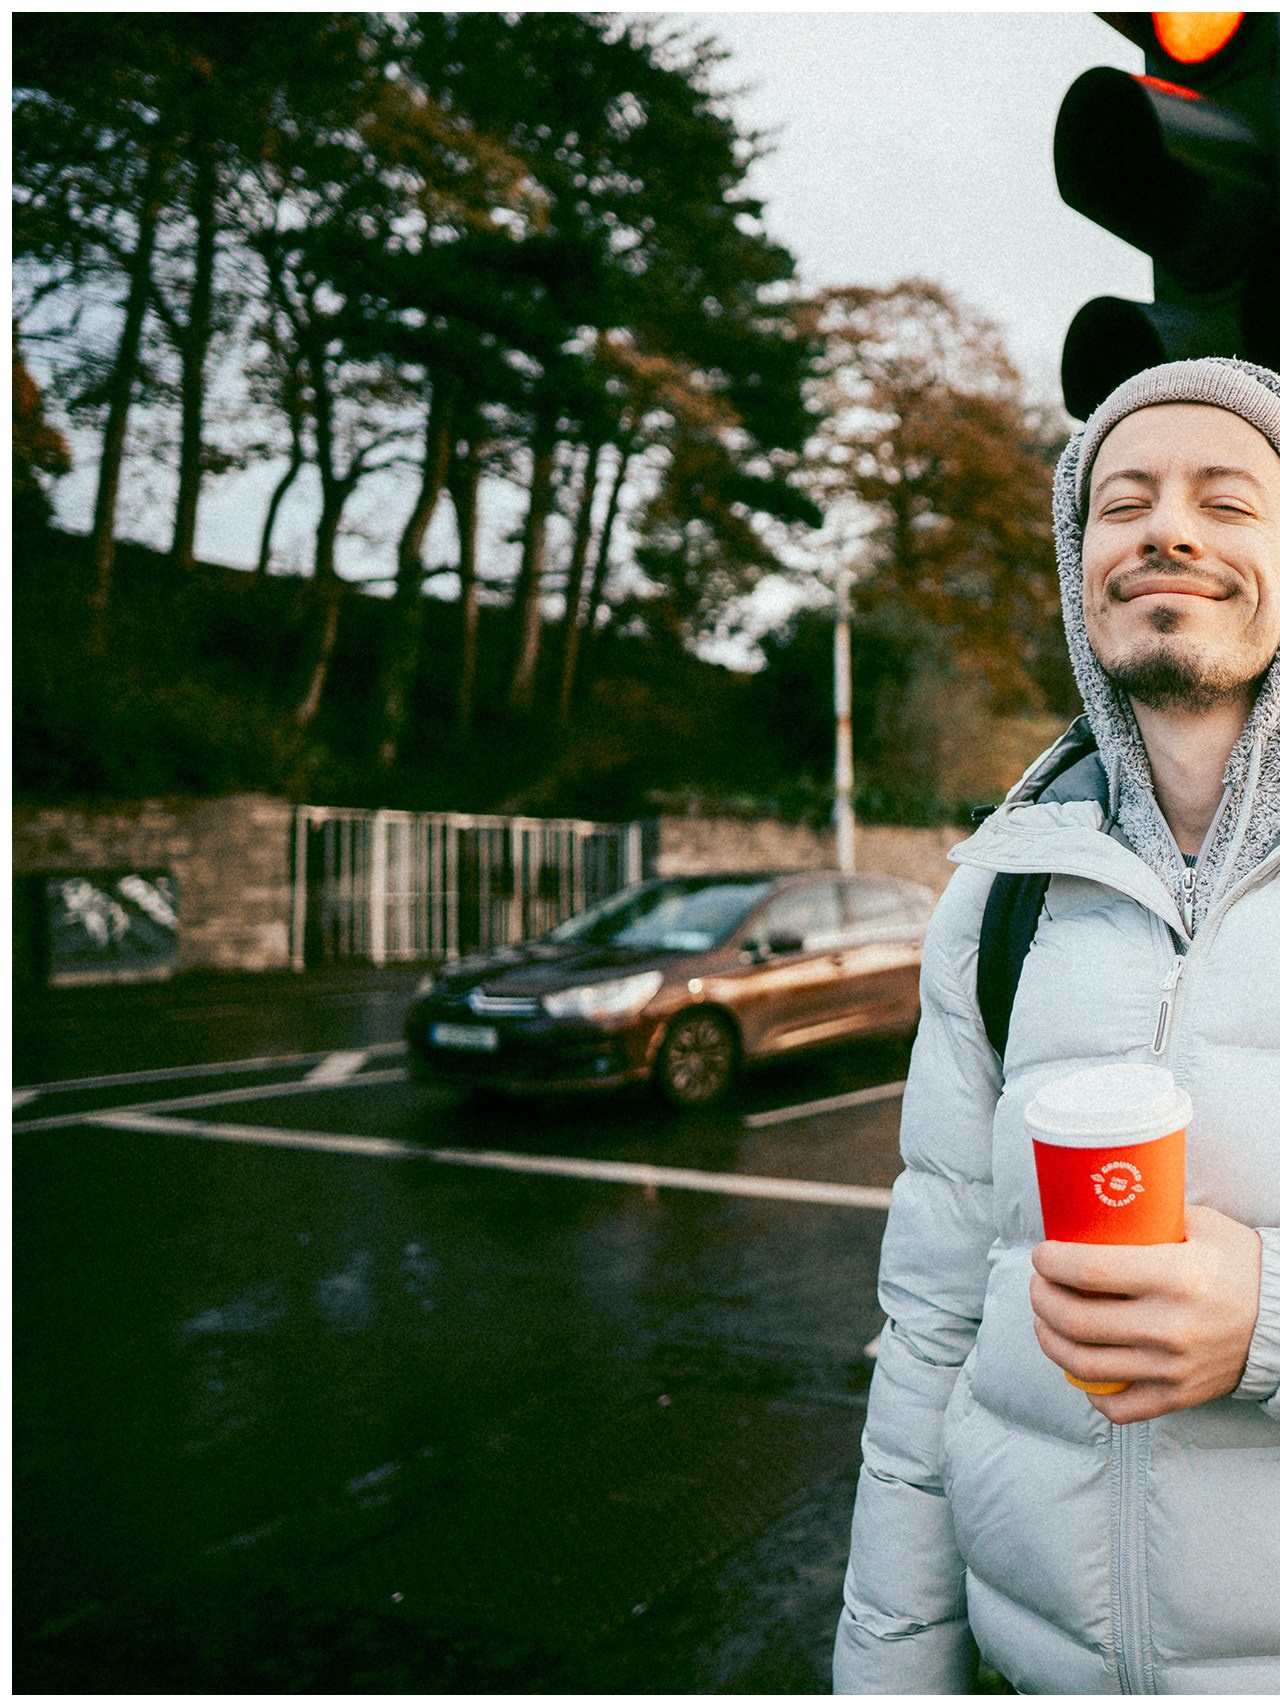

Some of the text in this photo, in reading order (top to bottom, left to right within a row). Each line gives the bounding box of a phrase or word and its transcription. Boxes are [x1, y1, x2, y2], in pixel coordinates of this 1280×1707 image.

[1101, 1161, 1142, 1182] GROUNDED
[1093, 1183, 1136, 1207] IN IRELAND
